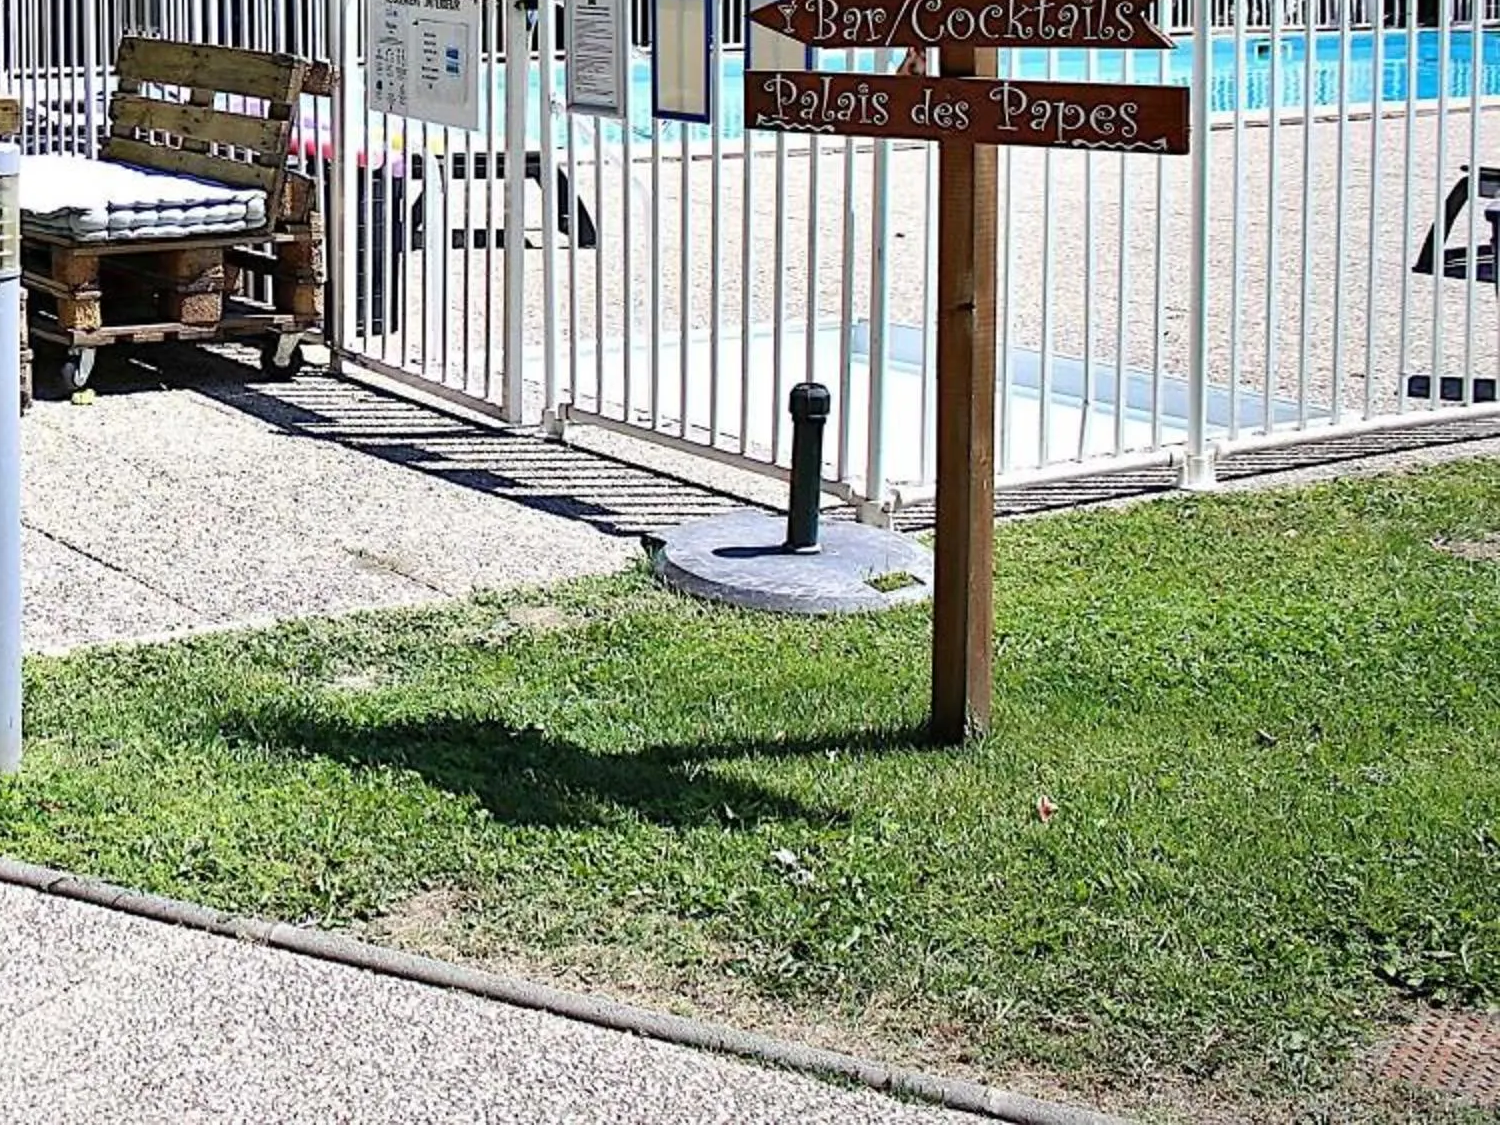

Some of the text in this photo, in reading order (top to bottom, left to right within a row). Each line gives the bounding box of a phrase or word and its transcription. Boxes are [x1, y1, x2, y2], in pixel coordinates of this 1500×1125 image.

[763, 73, 1139, 144] Palais des Papes
